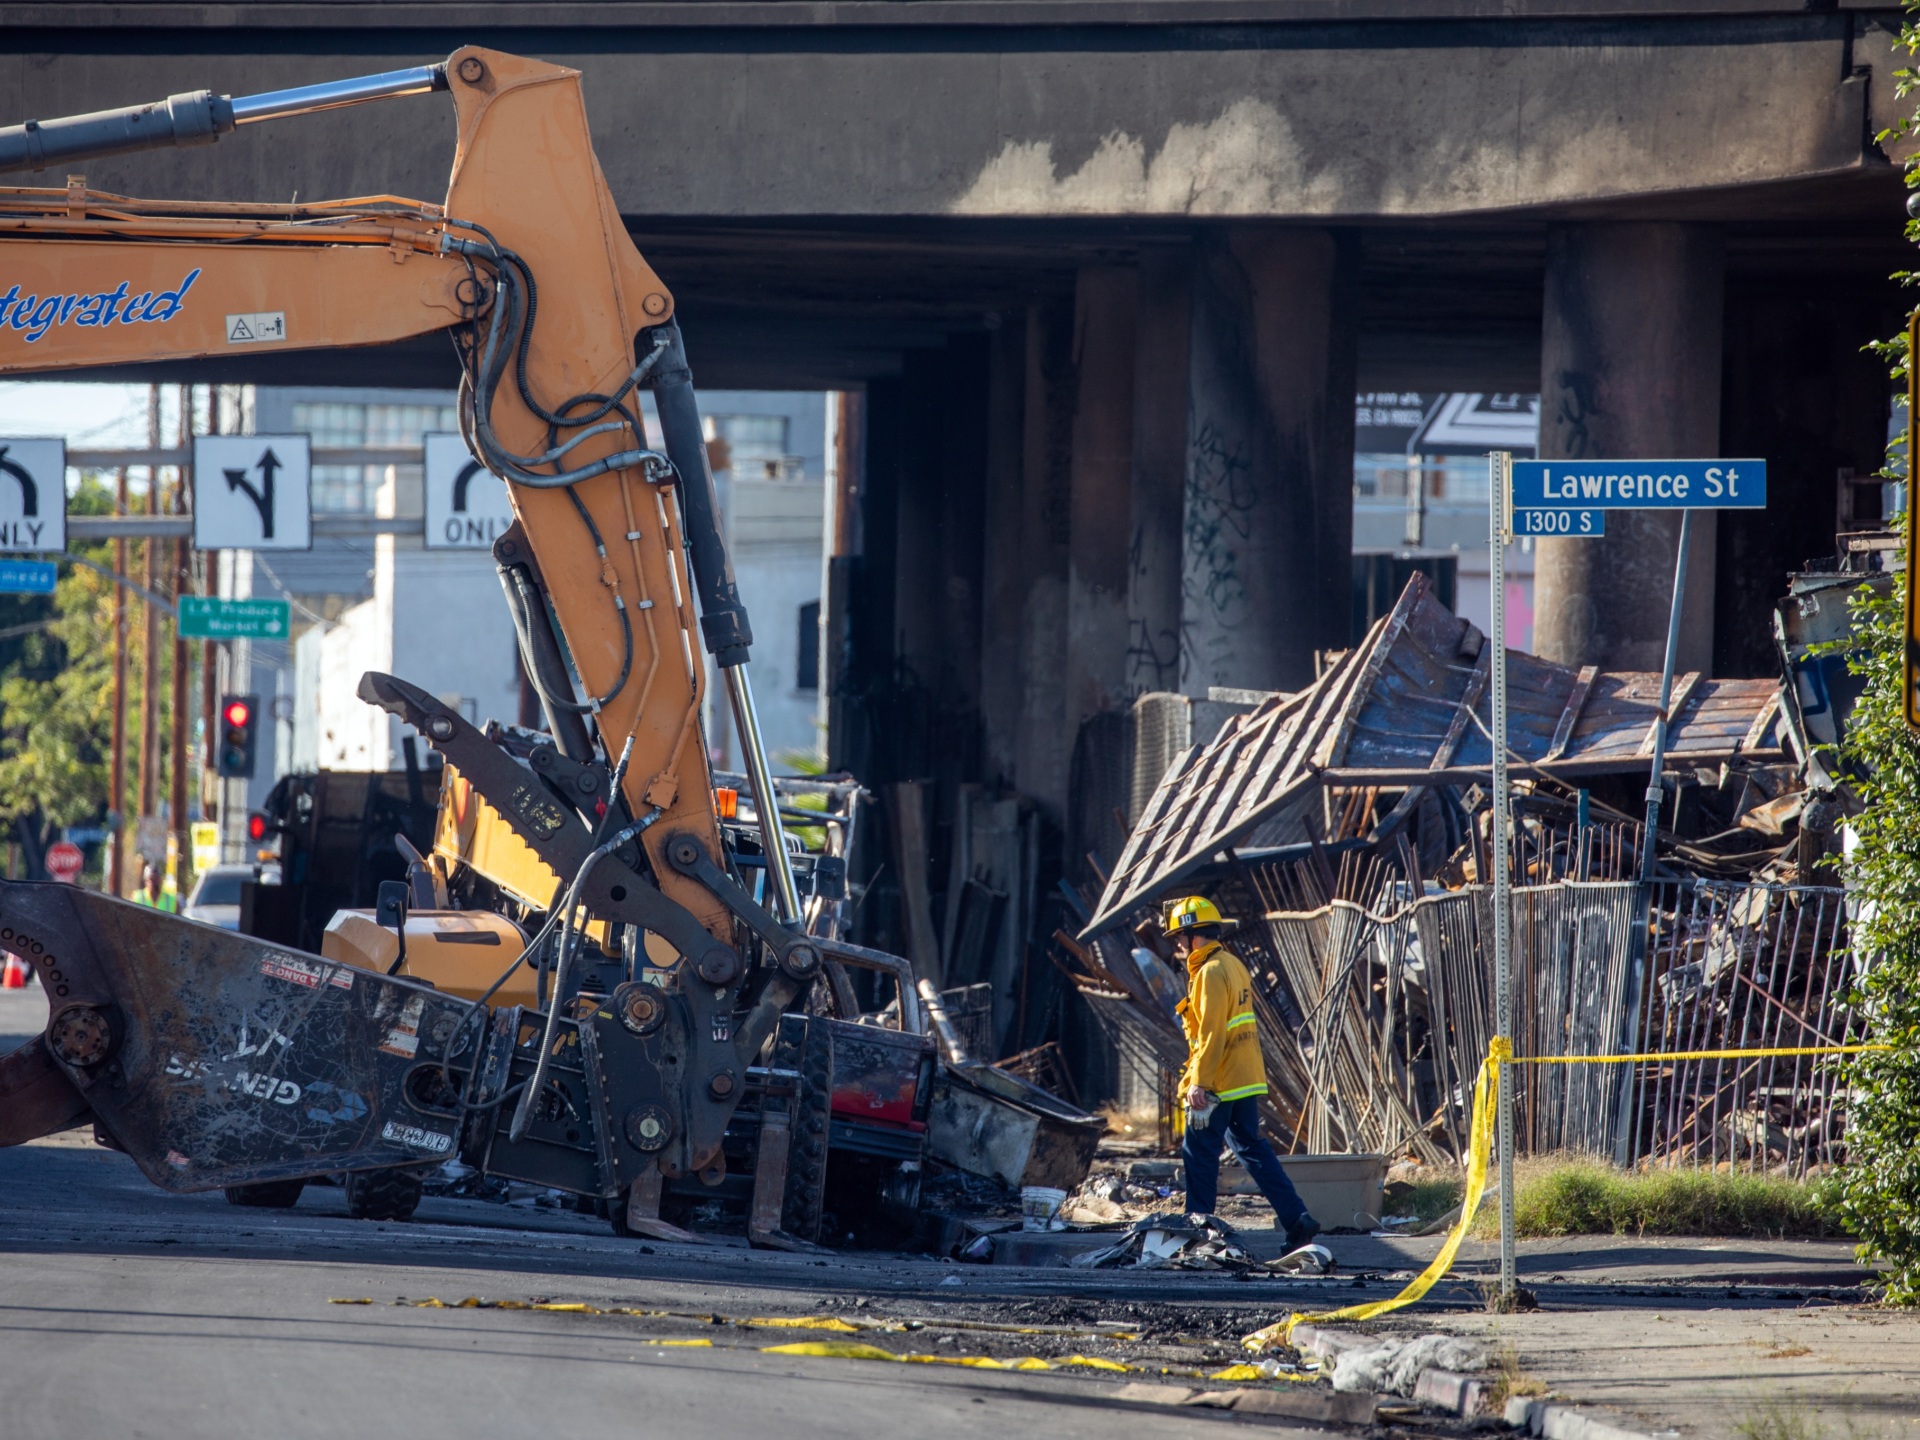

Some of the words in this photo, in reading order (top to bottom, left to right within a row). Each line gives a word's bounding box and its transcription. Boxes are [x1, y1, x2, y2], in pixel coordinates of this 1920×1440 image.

[1543, 468, 1690, 498] Lawrence
[1703, 467, 1739, 498] St
[1524, 511, 1571, 533] 1300
[1580, 511, 1592, 532] S
[50, 854, 78, 869] STOP
[1180, 914, 1192, 925] 10
[165, 1055, 301, 1104] GENIS
